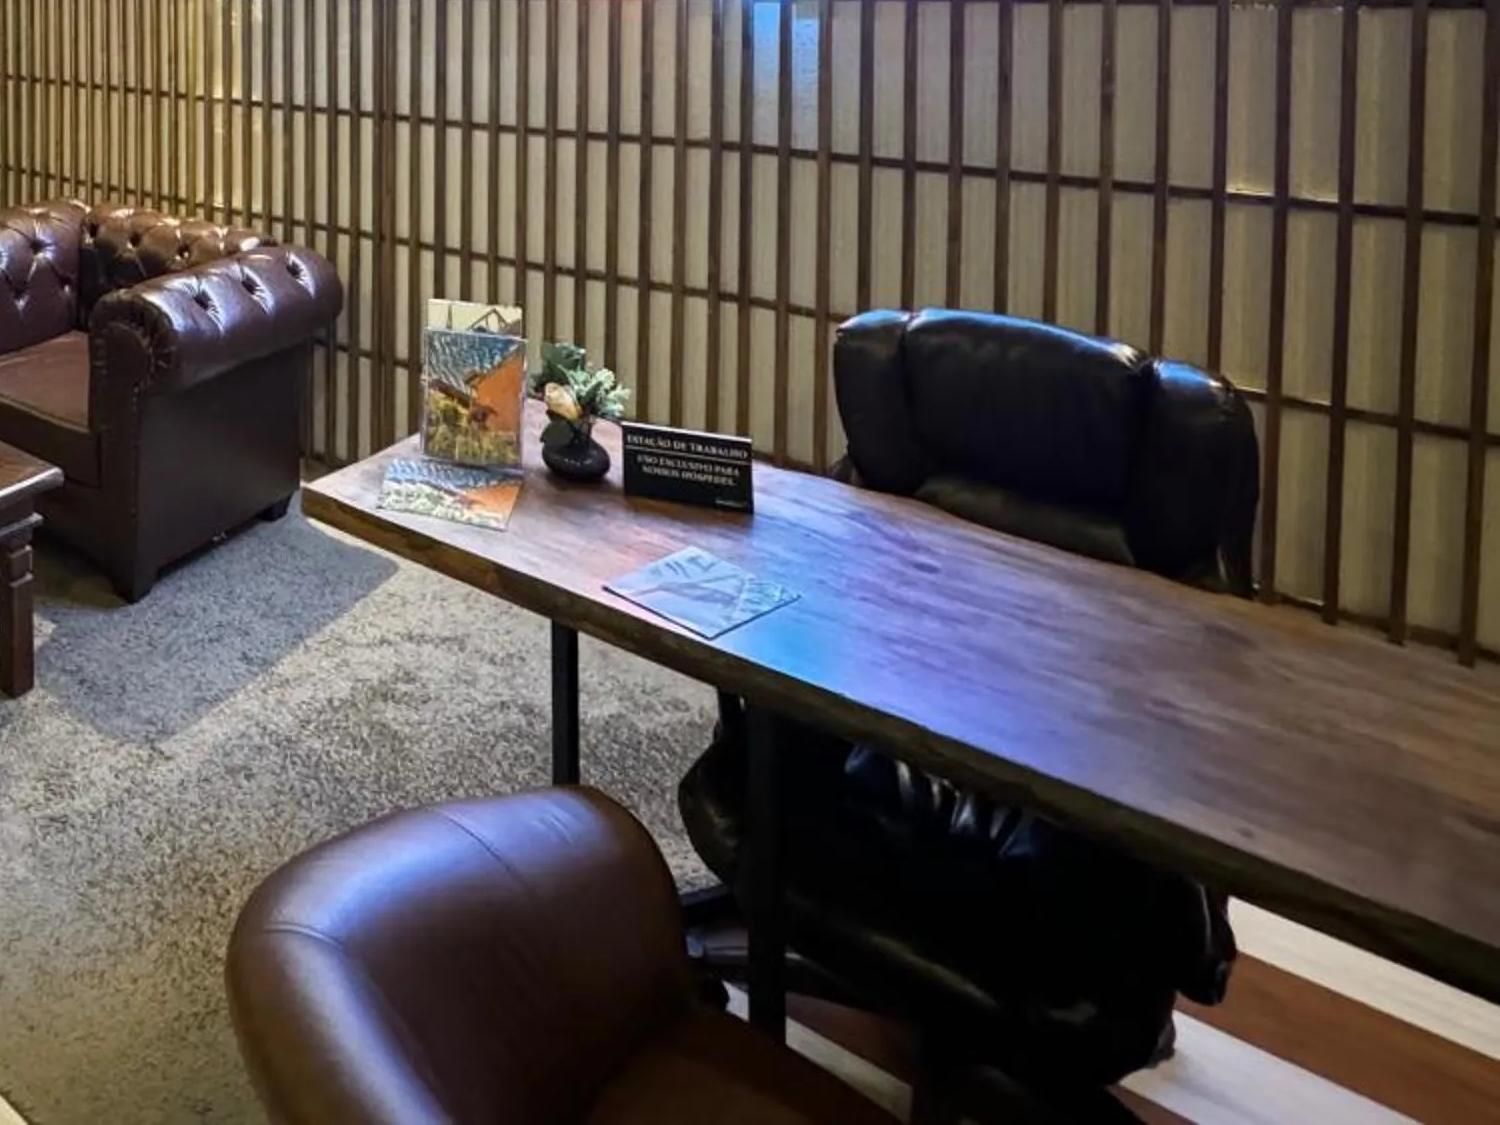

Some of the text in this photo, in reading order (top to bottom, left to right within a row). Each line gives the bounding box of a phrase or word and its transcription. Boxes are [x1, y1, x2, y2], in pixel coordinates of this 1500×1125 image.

[673, 440, 687, 449] DE
[690, 442, 748, 459] TRABALHO
[715, 465, 740, 477] PARA
